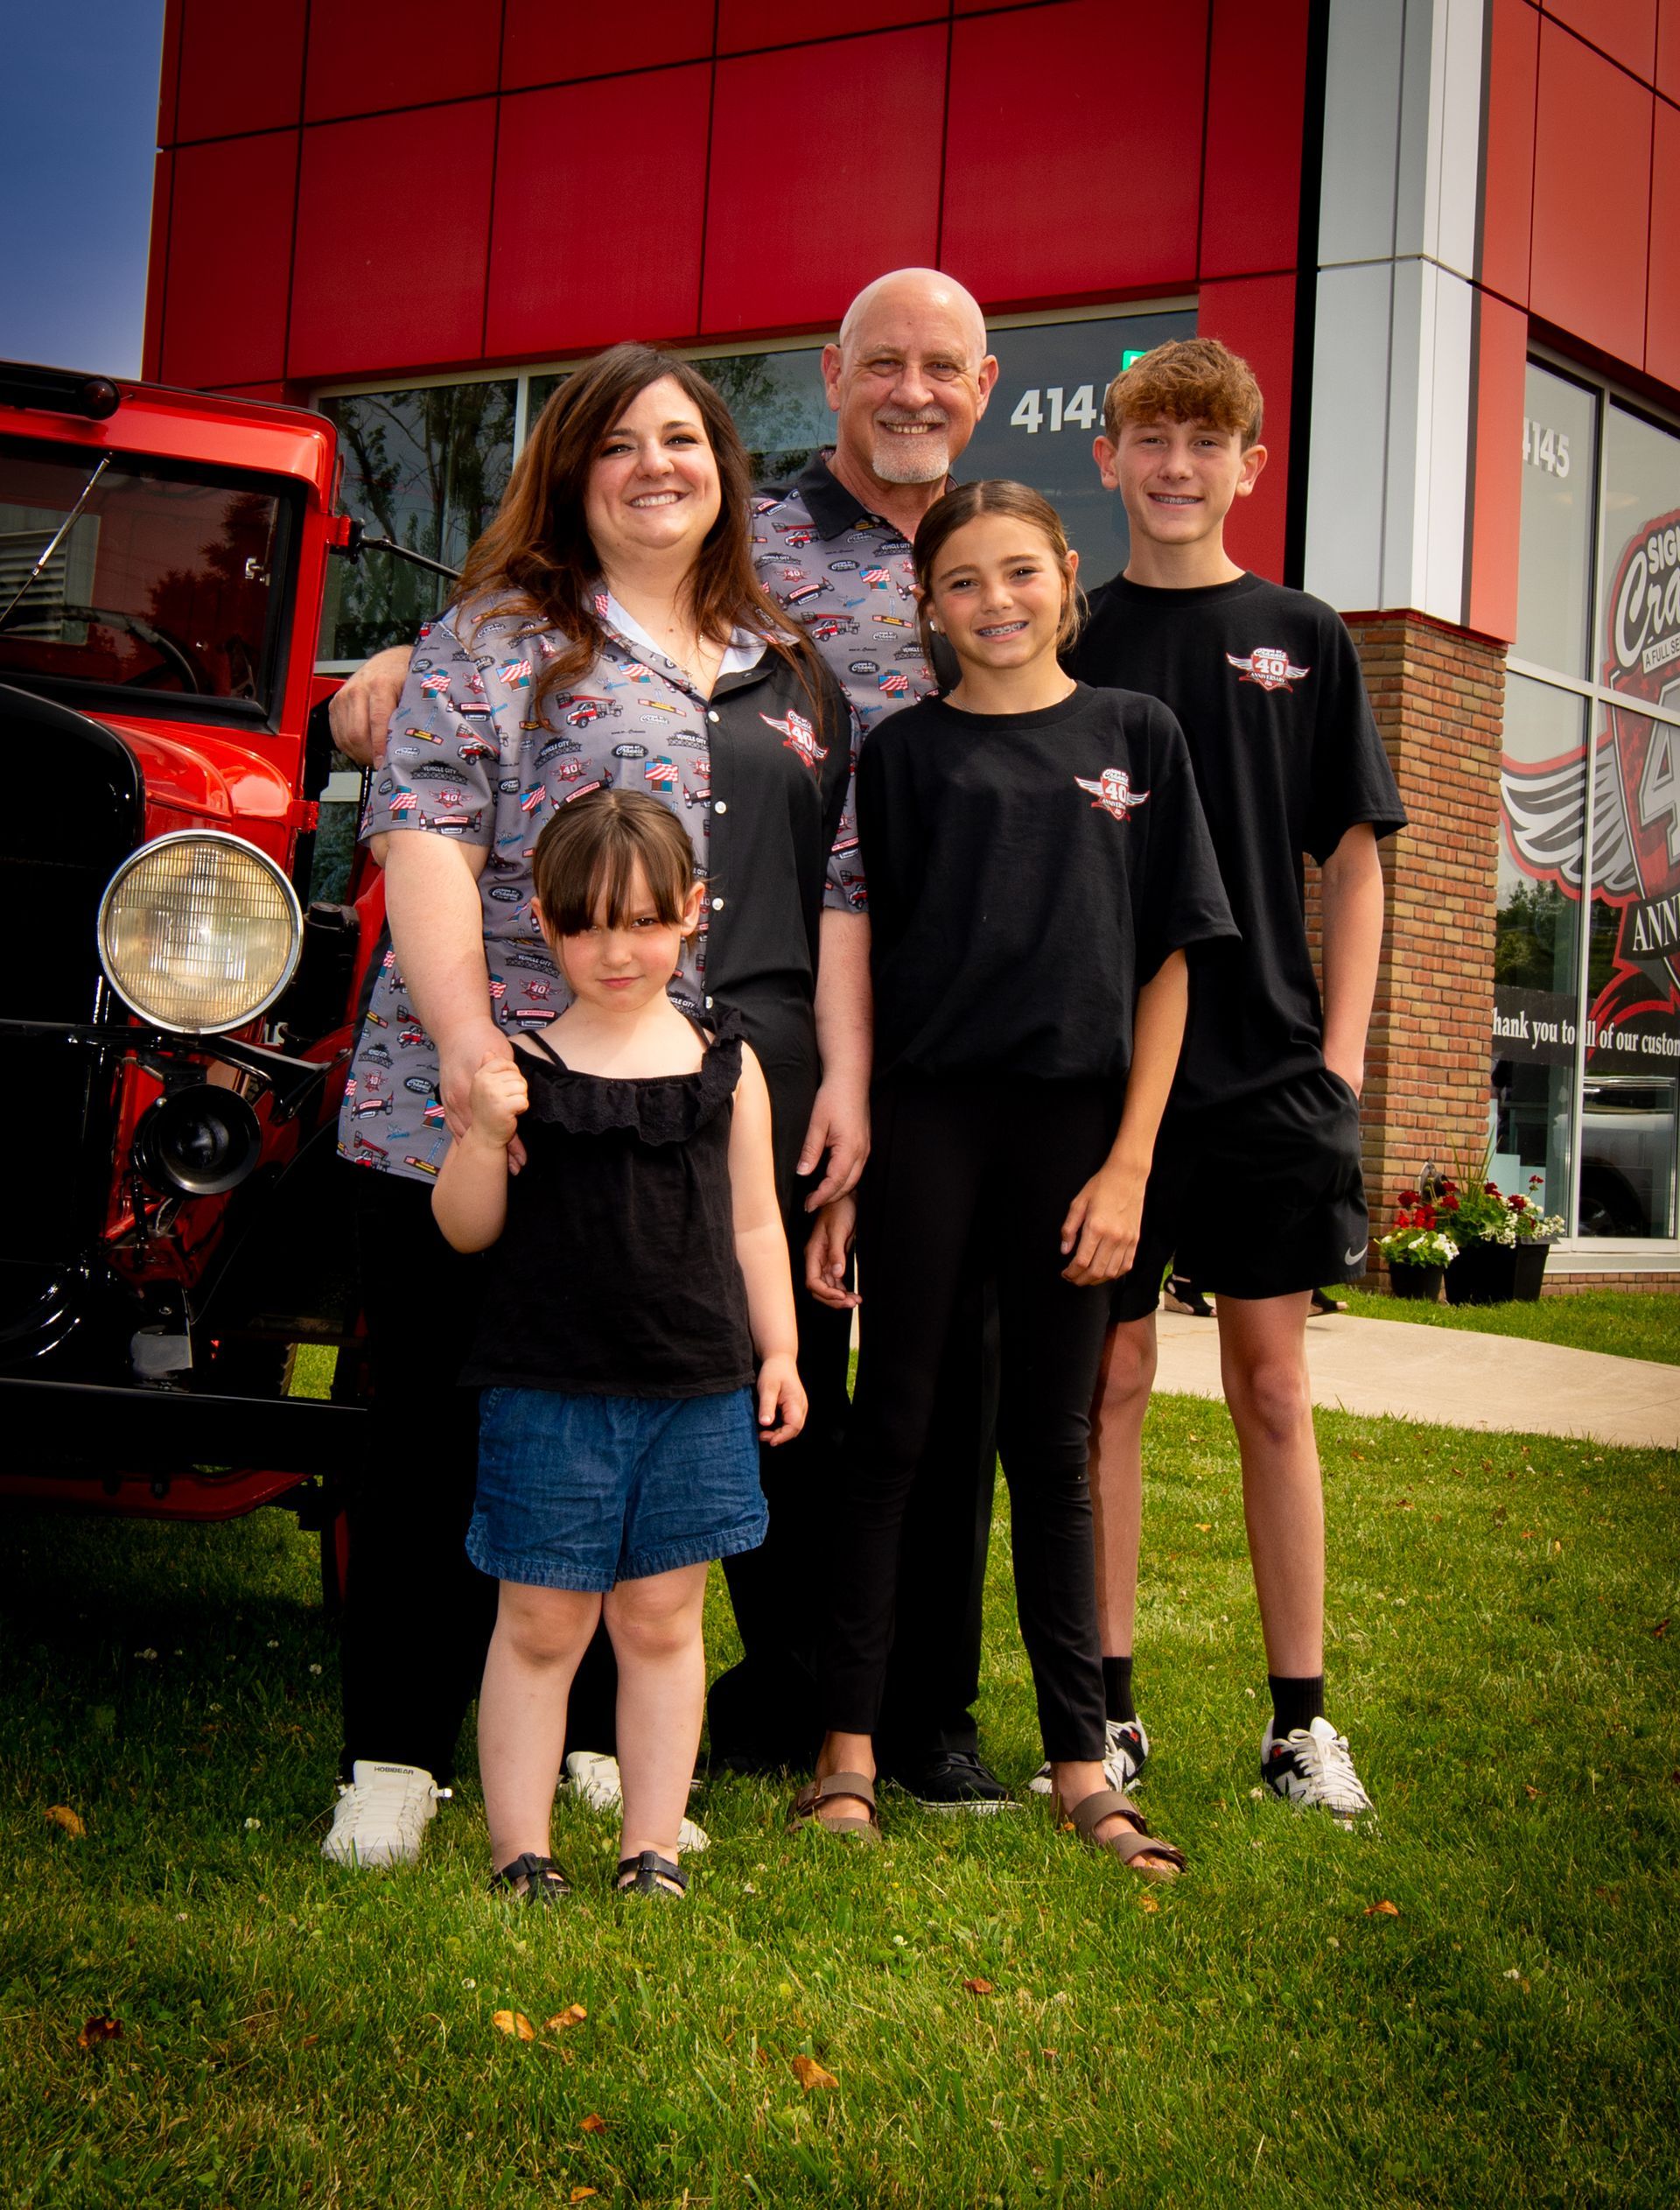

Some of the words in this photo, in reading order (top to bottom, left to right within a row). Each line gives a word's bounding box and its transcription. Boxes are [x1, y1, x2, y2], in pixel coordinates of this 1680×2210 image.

[1646, 652, 1651, 668] A
[1652, 643, 1670, 664] FULL
[1255, 658, 1284, 676] 40
[558, 739, 570, 748] CITY
[791, 726, 813, 751] 40
[423, 765, 444, 774] VEHICLE
[563, 765, 578, 775] 40
[1105, 782, 1127, 803] 40
[531, 984, 546, 994] 40
[1492, 1007, 1530, 1039] hank
[1532, 1021, 1558, 1049] you
[1562, 1020, 1575, 1045] to
[1600, 1022, 1614, 1049] of
[1616, 1031, 1638, 1052] our
